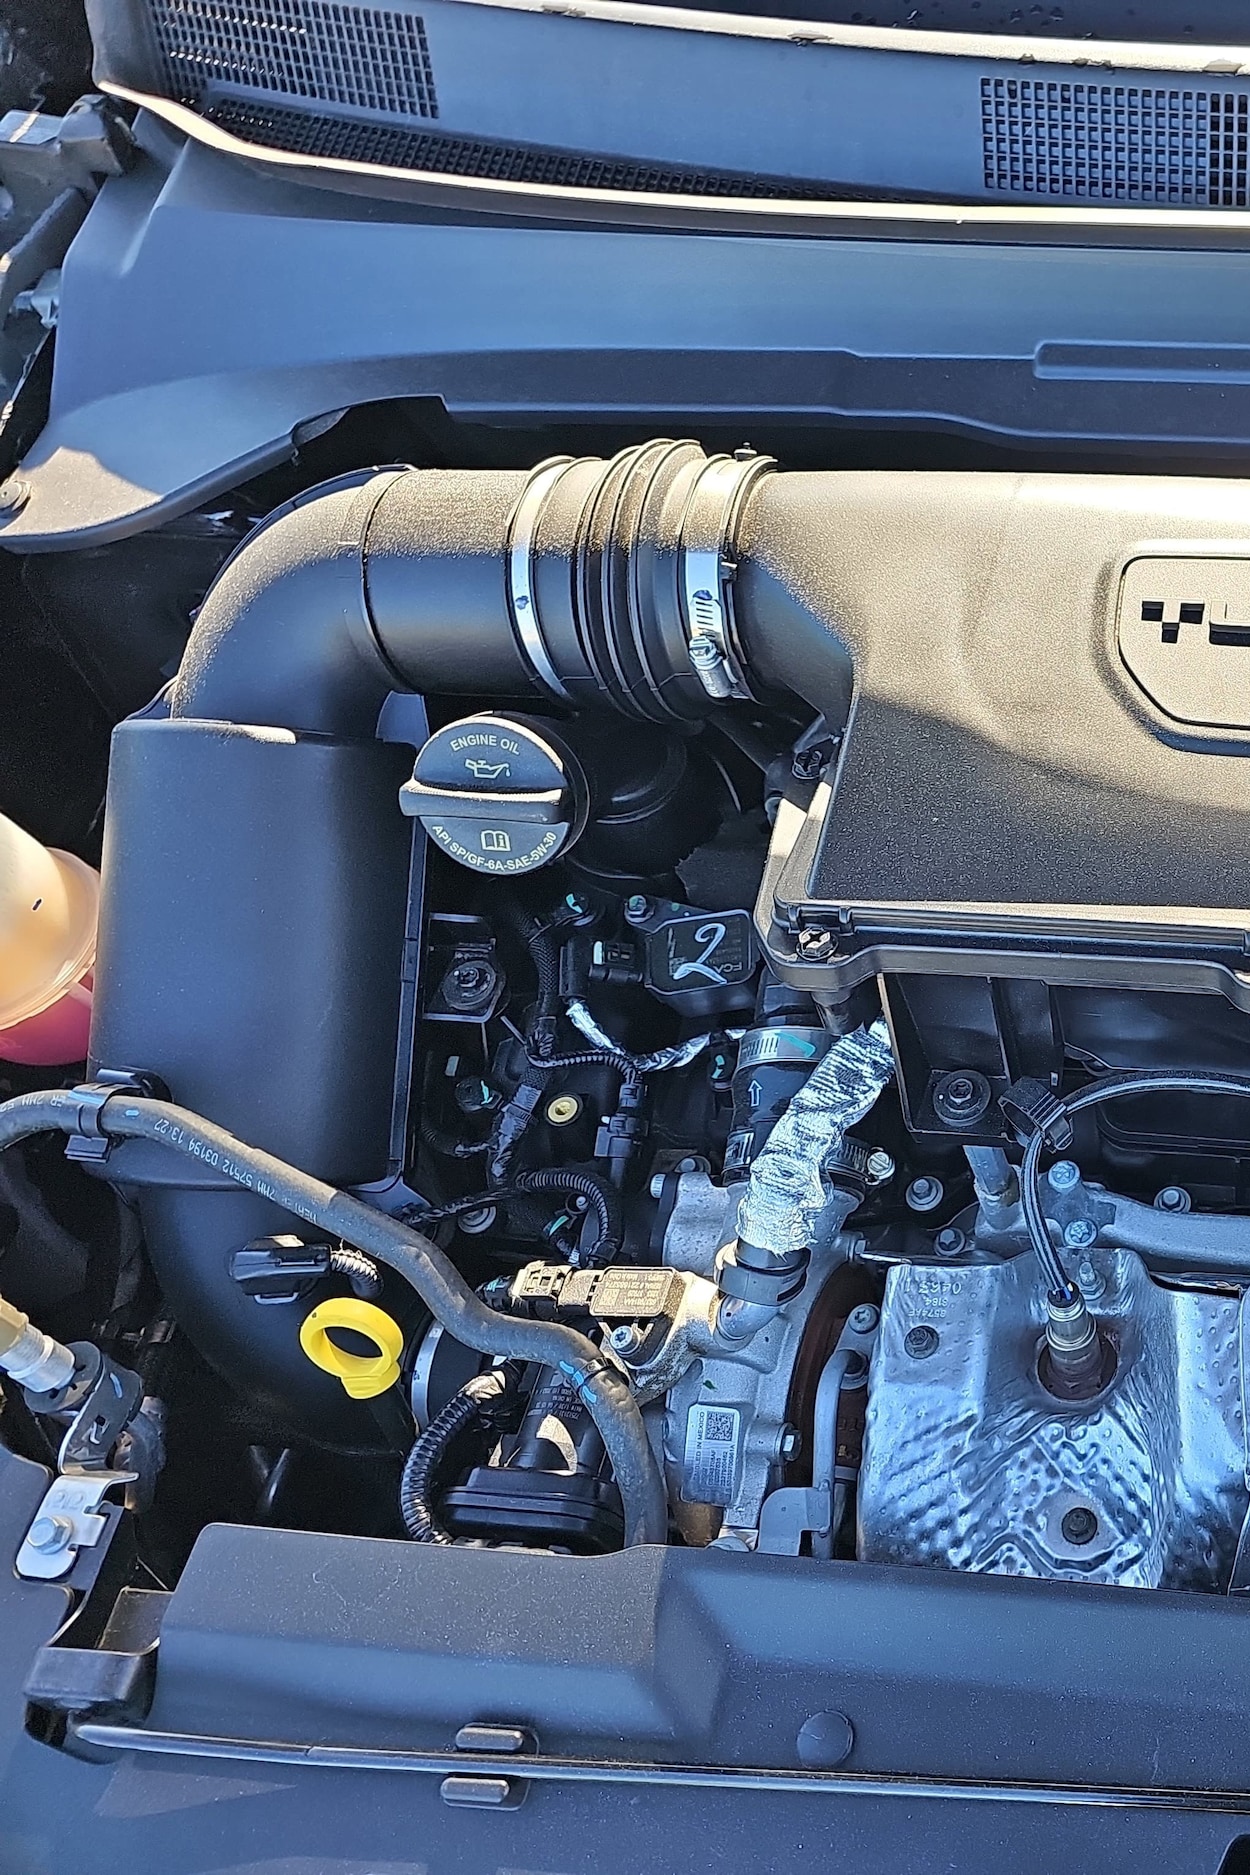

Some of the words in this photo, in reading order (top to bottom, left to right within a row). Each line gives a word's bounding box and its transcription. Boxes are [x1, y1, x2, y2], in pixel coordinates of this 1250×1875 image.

[450, 734, 497, 751] ENGINE
[500, 739, 520, 755] OIL
[432, 825, 451, 845] API
[450, 832, 557, 871] SP/GF-6A-SAE-5W-30
[188, 1137, 219, 1166] 03194
[222, 1159, 252, 1187] 57512
[695, 1411, 705, 1440] MEXICO
[695, 1441, 702, 1449] IN
